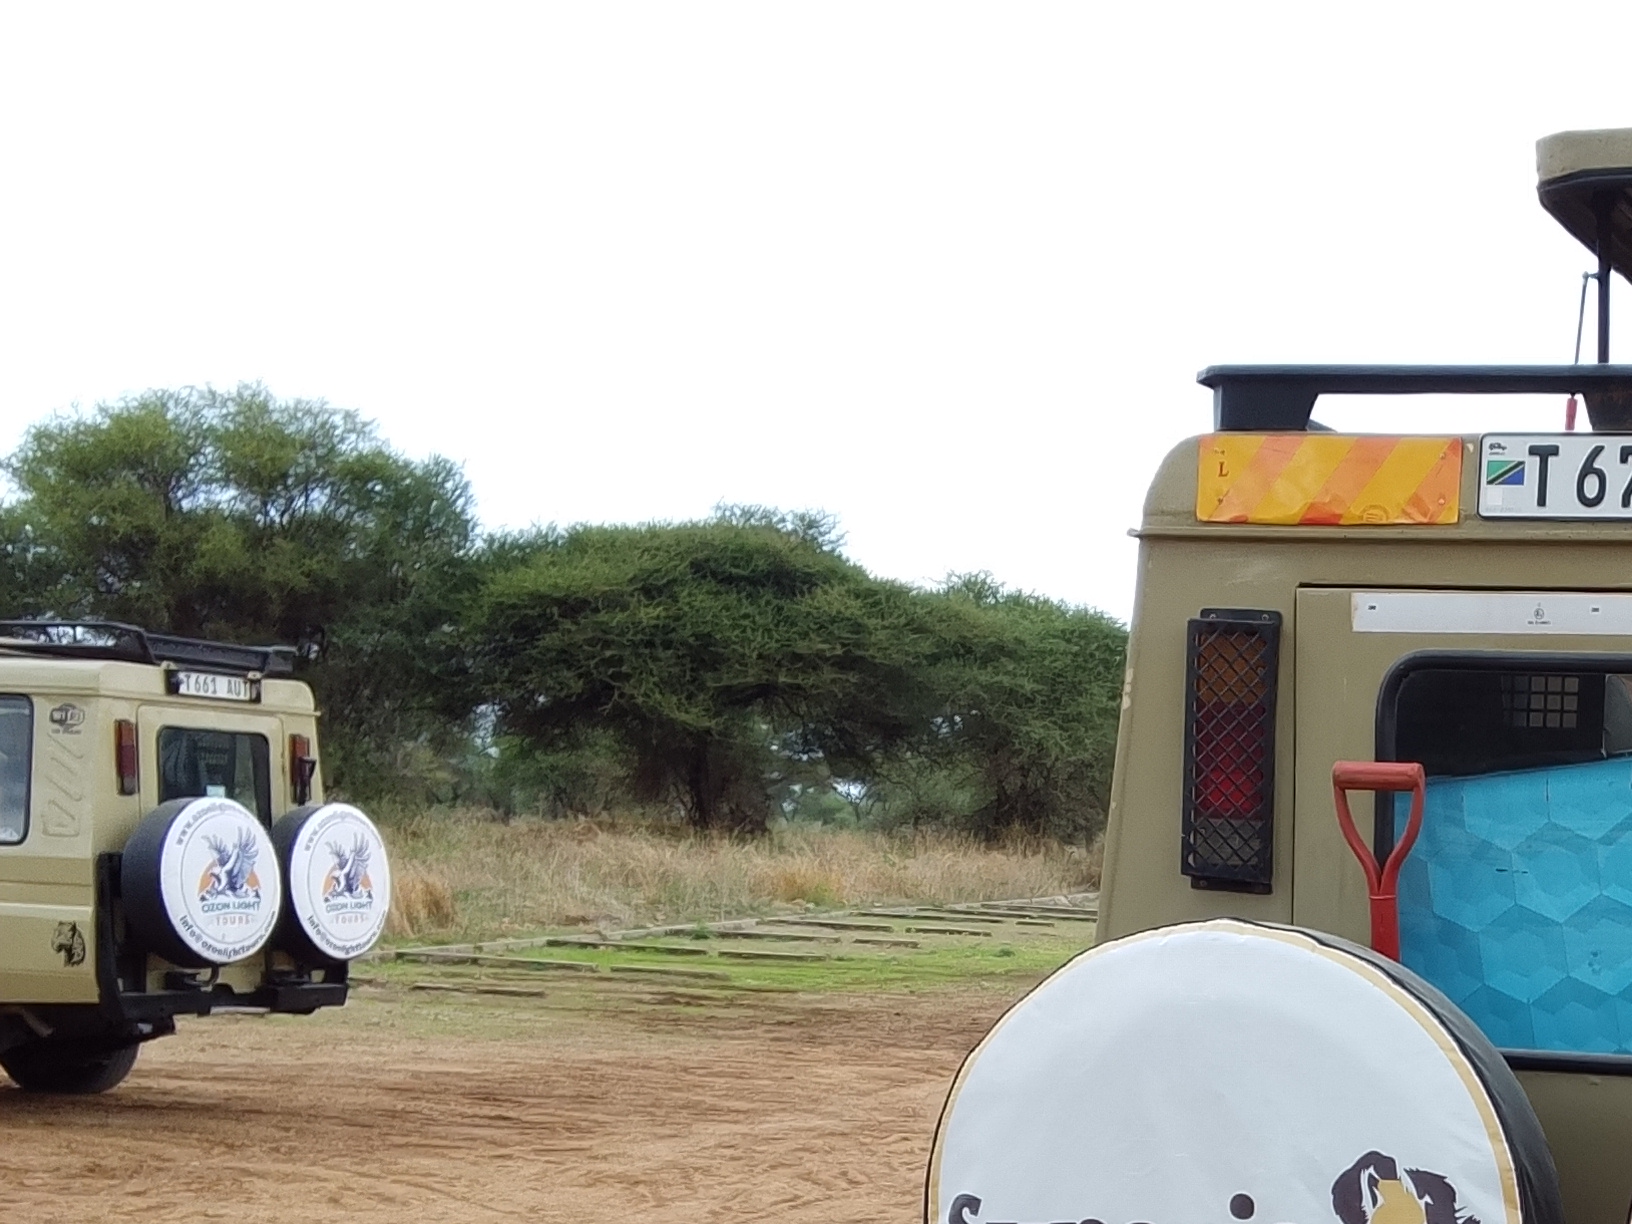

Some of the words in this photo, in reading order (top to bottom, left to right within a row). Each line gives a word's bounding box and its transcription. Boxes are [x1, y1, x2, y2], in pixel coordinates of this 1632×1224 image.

[1528, 444, 1560, 508] T
[184, 673, 191, 692] T
[194, 674, 218, 695] 661
[201, 900, 231, 913] OZON
[232, 899, 262, 912] LIGHT
[349, 900, 373, 912] LIGHT
[215, 914, 252, 927] TOURS
[334, 913, 365, 925] TOURS
